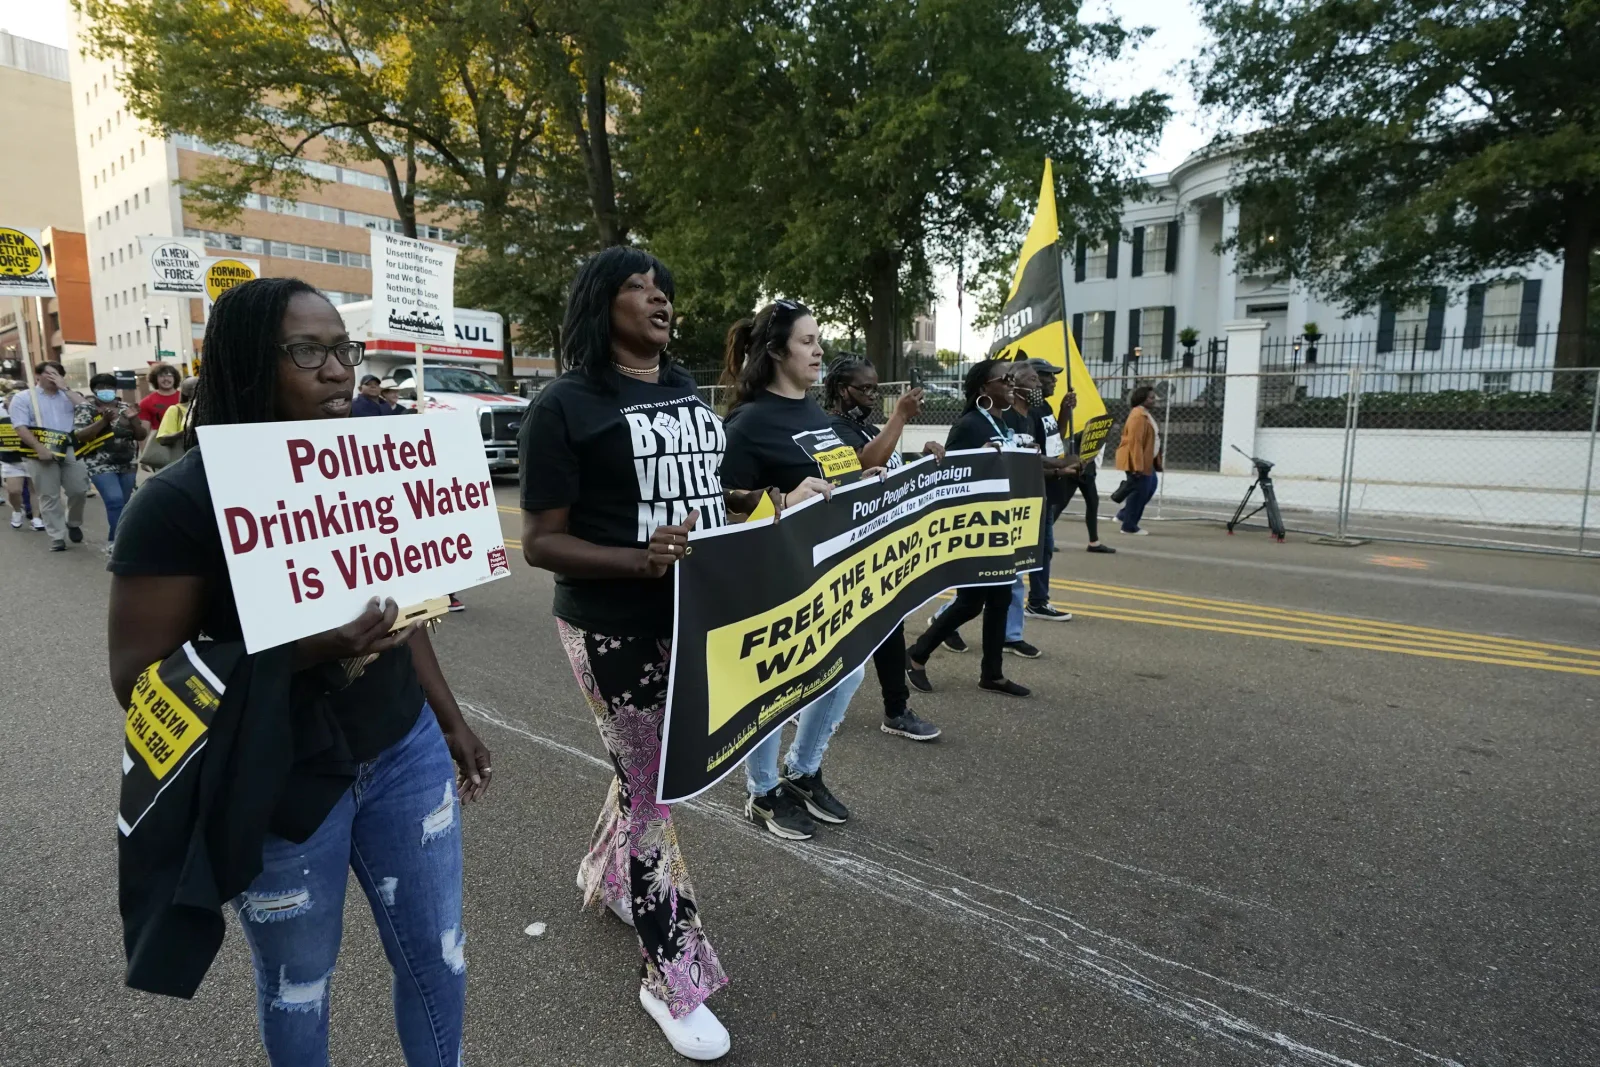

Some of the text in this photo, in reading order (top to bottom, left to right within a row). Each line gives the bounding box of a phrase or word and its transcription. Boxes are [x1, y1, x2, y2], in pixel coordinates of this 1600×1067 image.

[0, 245, 39, 258] ETTLING
[161, 248, 189, 259] A NEW
[386, 235, 397, 244] We
[419, 242, 435, 253] New
[0, 255, 30, 268] ORCE
[154, 259, 200, 269] UNSETTLING
[386, 247, 443, 267] Unsettling Force
[386, 259, 396, 268] for
[164, 268, 195, 280] FORCE
[212, 266, 251, 279] FORWARD
[386, 272, 427, 286] and We Got
[386, 283, 439, 299] Nothing to Lose
[387, 294, 440, 310] But Our Chains.
[455, 324, 494, 343] AUL
[994, 306, 1032, 343] aign
[286, 428, 437, 483] Polluted
[853, 466, 972, 520] Poor People's Campaign
[223, 477, 491, 555] Drinking Water
[850, 533, 856, 543] A
[857, 515, 889, 538] NATIONAL
[890, 508, 904, 520] CALL
[906, 501, 916, 511] for
[935, 485, 971, 498] REVIVAL
[285, 532, 473, 604] is Violence
[740, 506, 1031, 660] FREE THE LAND, CLEAN HE
[756, 599, 853, 684] WATER
[859, 585, 874, 609] &
[880, 552, 920, 595] KEEP
[925, 540, 941, 564] IT
[803, 671, 827, 693] KAIRS
[144, 689, 157, 705] &
[150, 696, 189, 740] WATER
[131, 712, 175, 764] FREE THE
[707, 719, 757, 765] REPAIRERS
